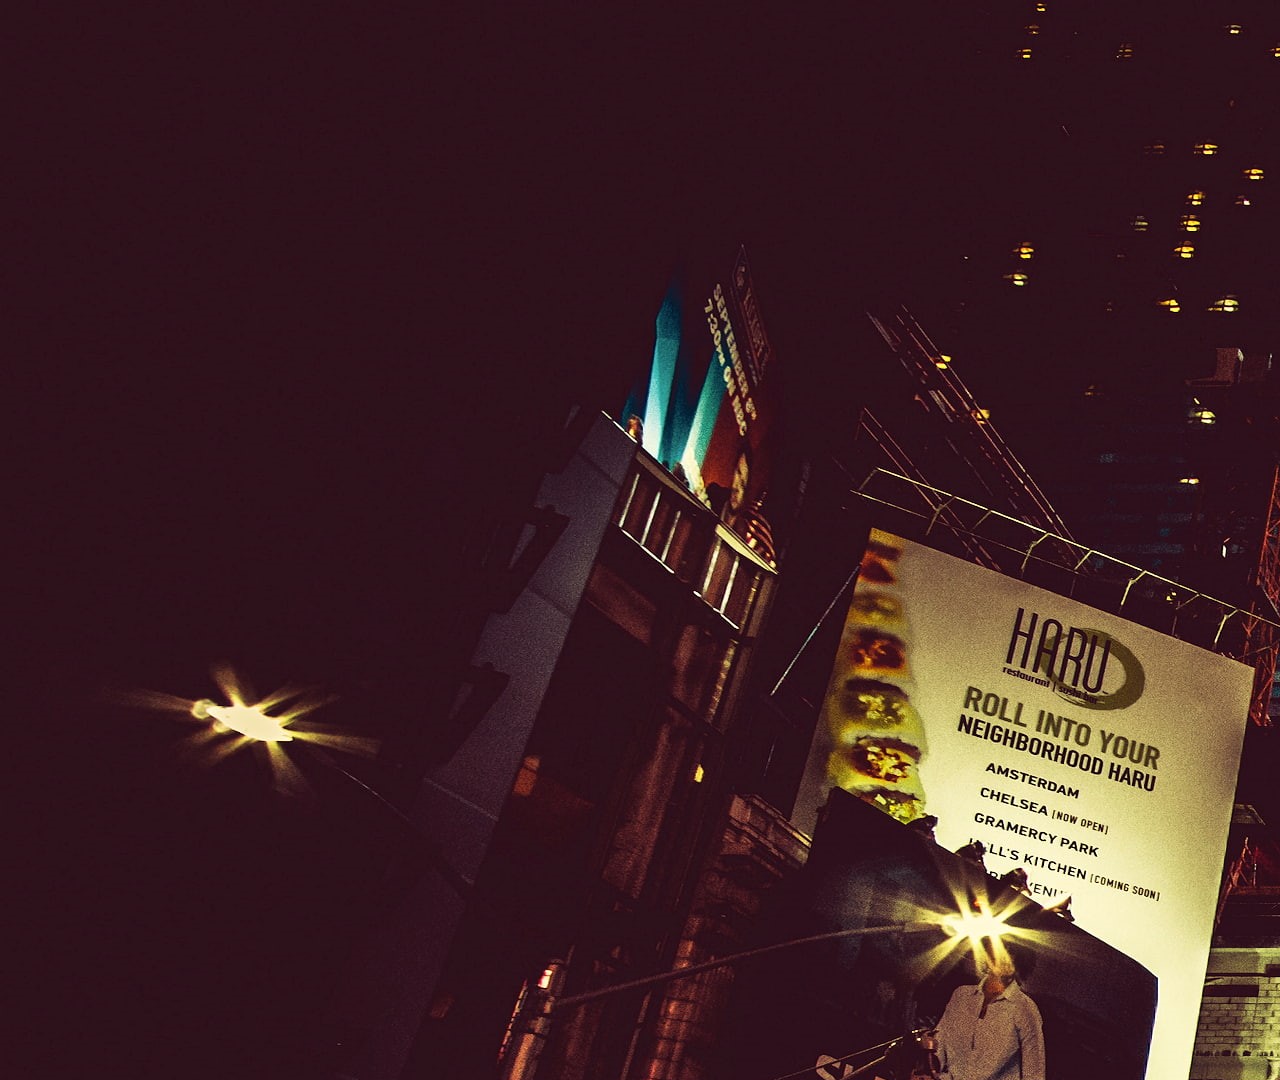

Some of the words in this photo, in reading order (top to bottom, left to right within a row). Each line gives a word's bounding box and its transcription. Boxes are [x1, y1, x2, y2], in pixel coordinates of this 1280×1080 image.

[1002, 666, 1050, 688] restaurant
[1005, 607, 1112, 694] HARU
[957, 713, 1104, 775] NEIGHBORHOOD
[1107, 762, 1157, 792] HARU
[963, 685, 1028, 728] ROLL
[1035, 709, 1091, 747] INTO
[1099, 729, 1161, 770] YOUR
[985, 762, 1080, 799] AMSTERDAM
[974, 812, 1058, 847] GRAMERCY
[1060, 837, 1100, 857] PARK
[980, 787, 1048, 816] CHELSEA
[1051, 809, 1078, 825] [NOW
[1080, 818, 1109, 835] OPEN]
[969, 837, 1019, 861] LL'S
[1023, 853, 1088, 880] KITCHEN
[1090, 873, 1130, 892] [COMING
[1131, 885, 1161, 902] SOON]
